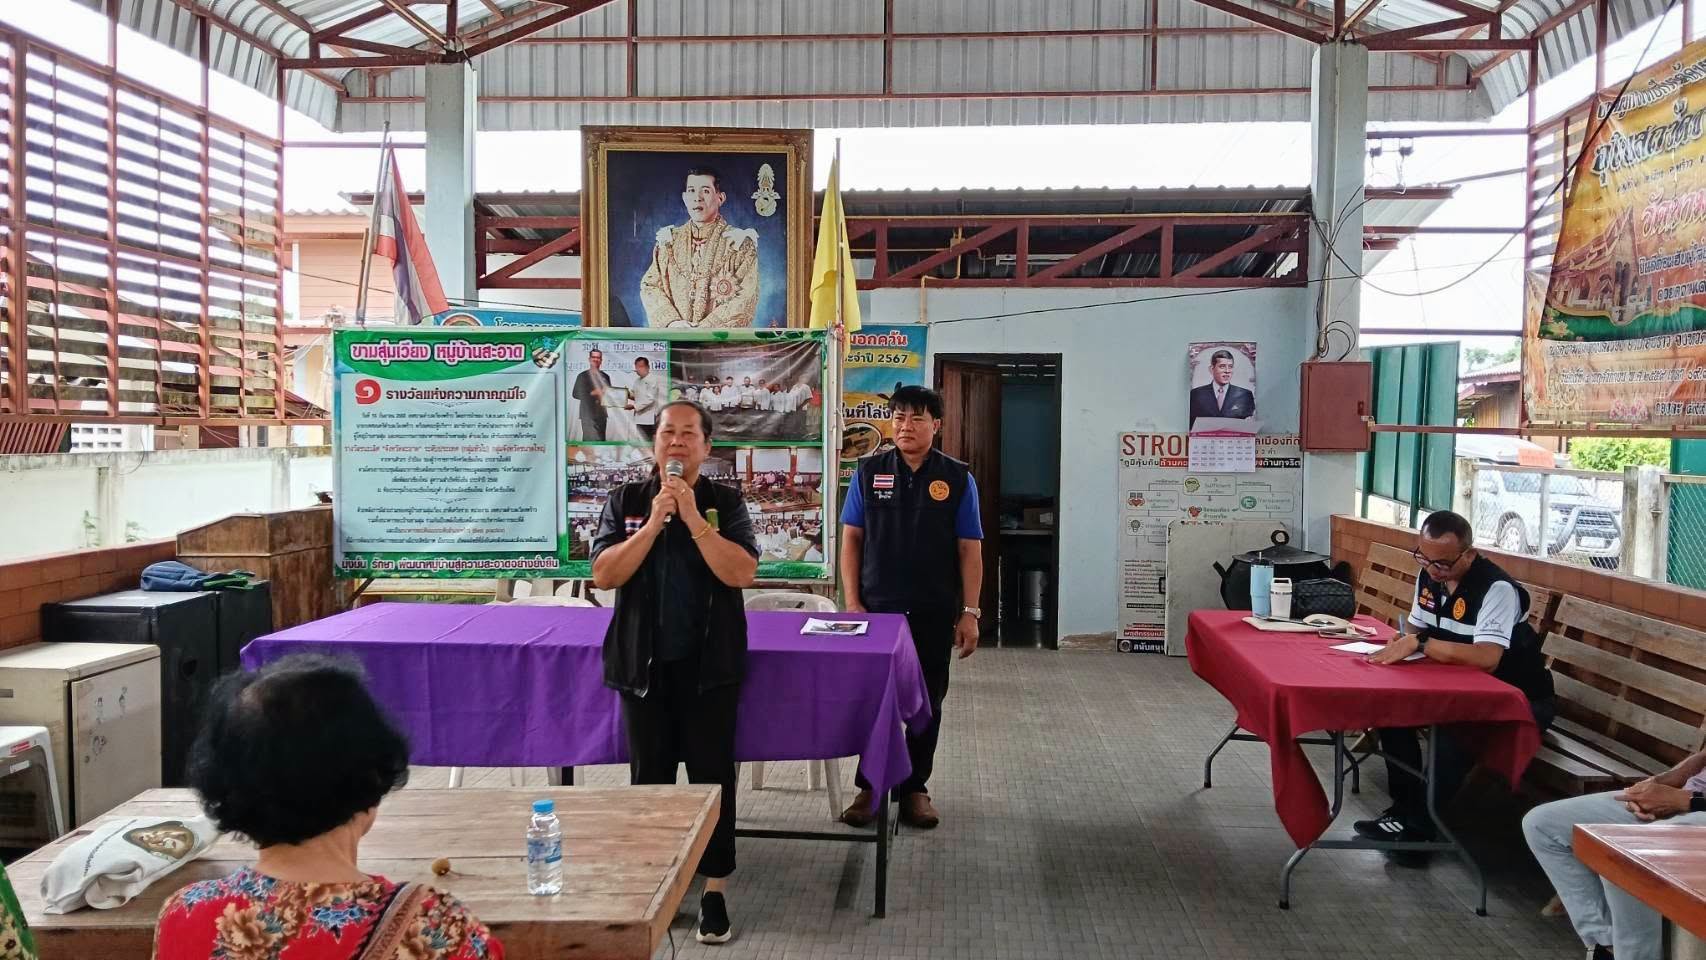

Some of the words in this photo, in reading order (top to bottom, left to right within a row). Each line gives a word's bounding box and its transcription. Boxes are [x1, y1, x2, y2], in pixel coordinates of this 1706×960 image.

[436, 341, 523, 367] หมู่บ้านสะอาด
[844, 352, 874, 363] ะจำปี
[877, 353, 908, 364] 2567
[1122, 434, 1189, 456] STRO
[372, 558, 393, 569] รักษา
